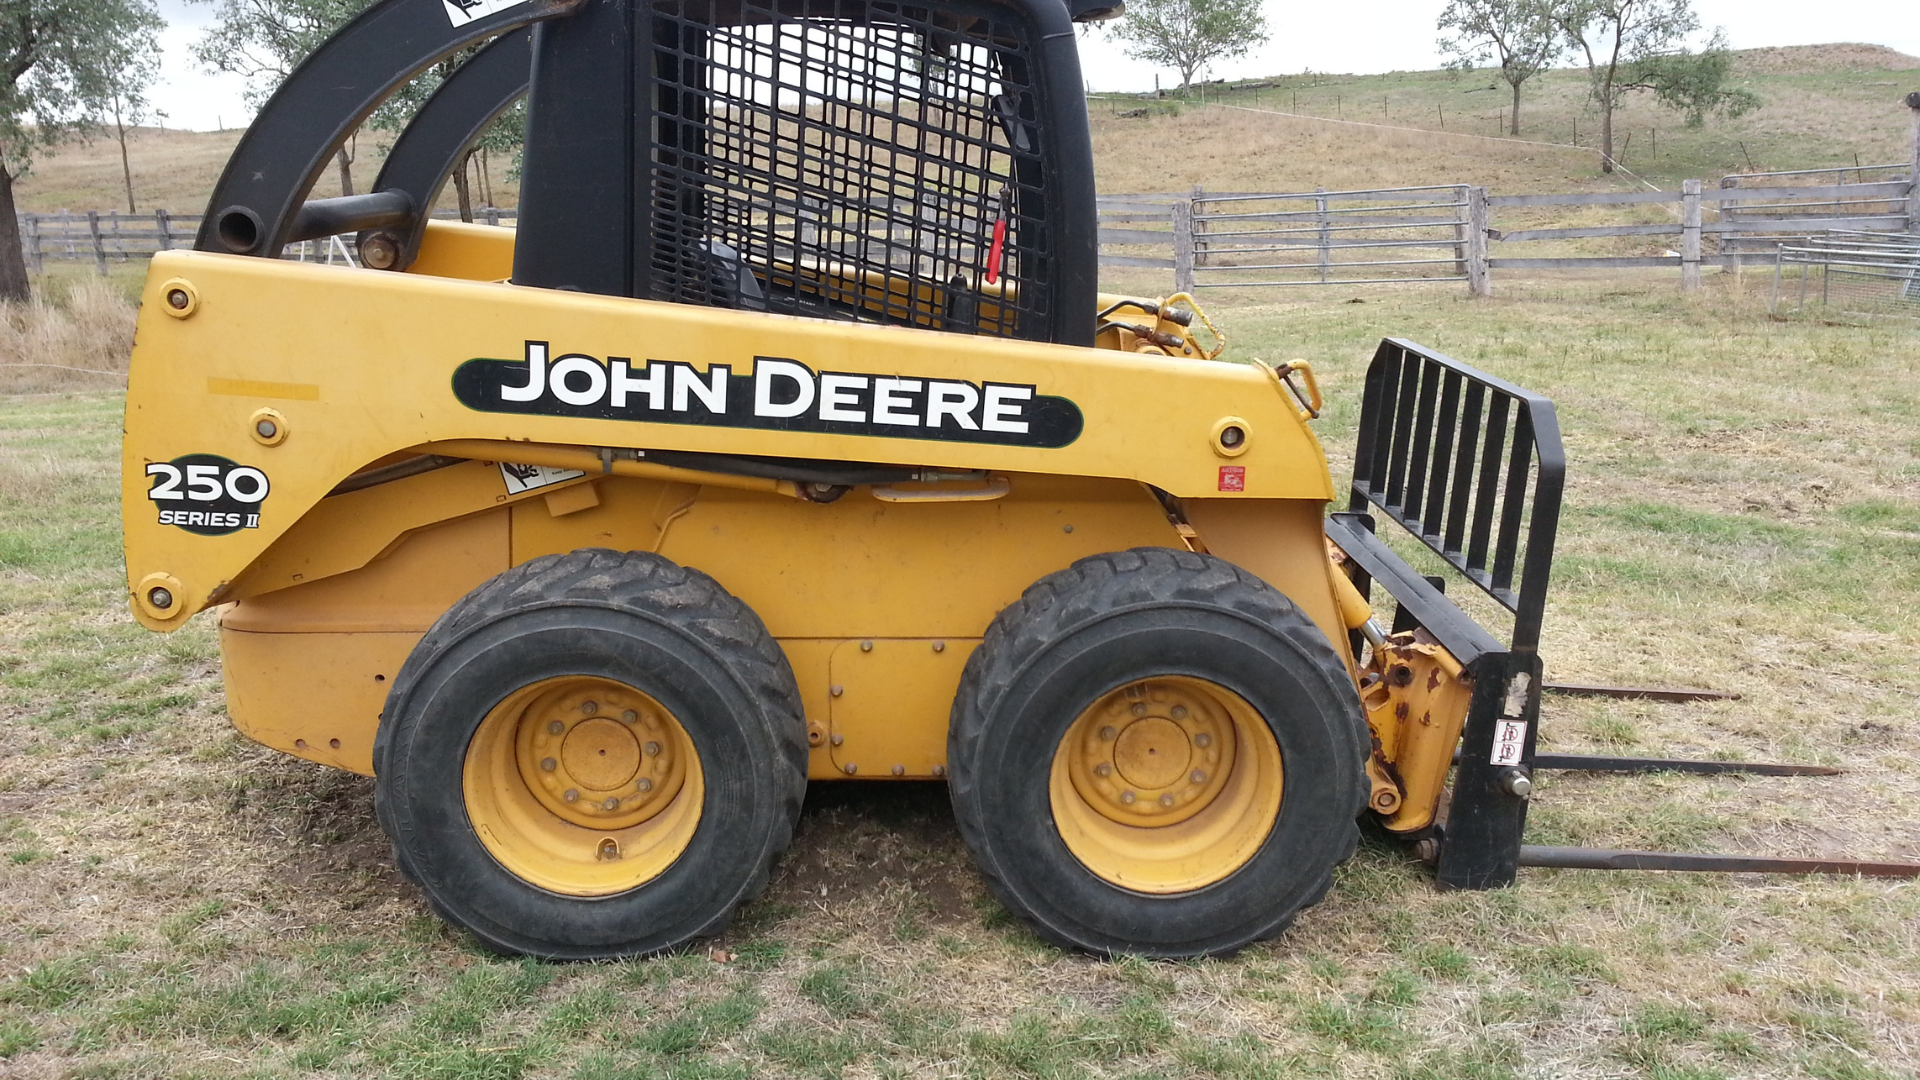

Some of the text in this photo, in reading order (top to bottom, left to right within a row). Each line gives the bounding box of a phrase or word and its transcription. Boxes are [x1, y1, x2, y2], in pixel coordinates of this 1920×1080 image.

[501, 344, 1032, 434] JOHN DEERE
[147, 463, 268, 503] 250
[159, 510, 260, 528] SERIES II
